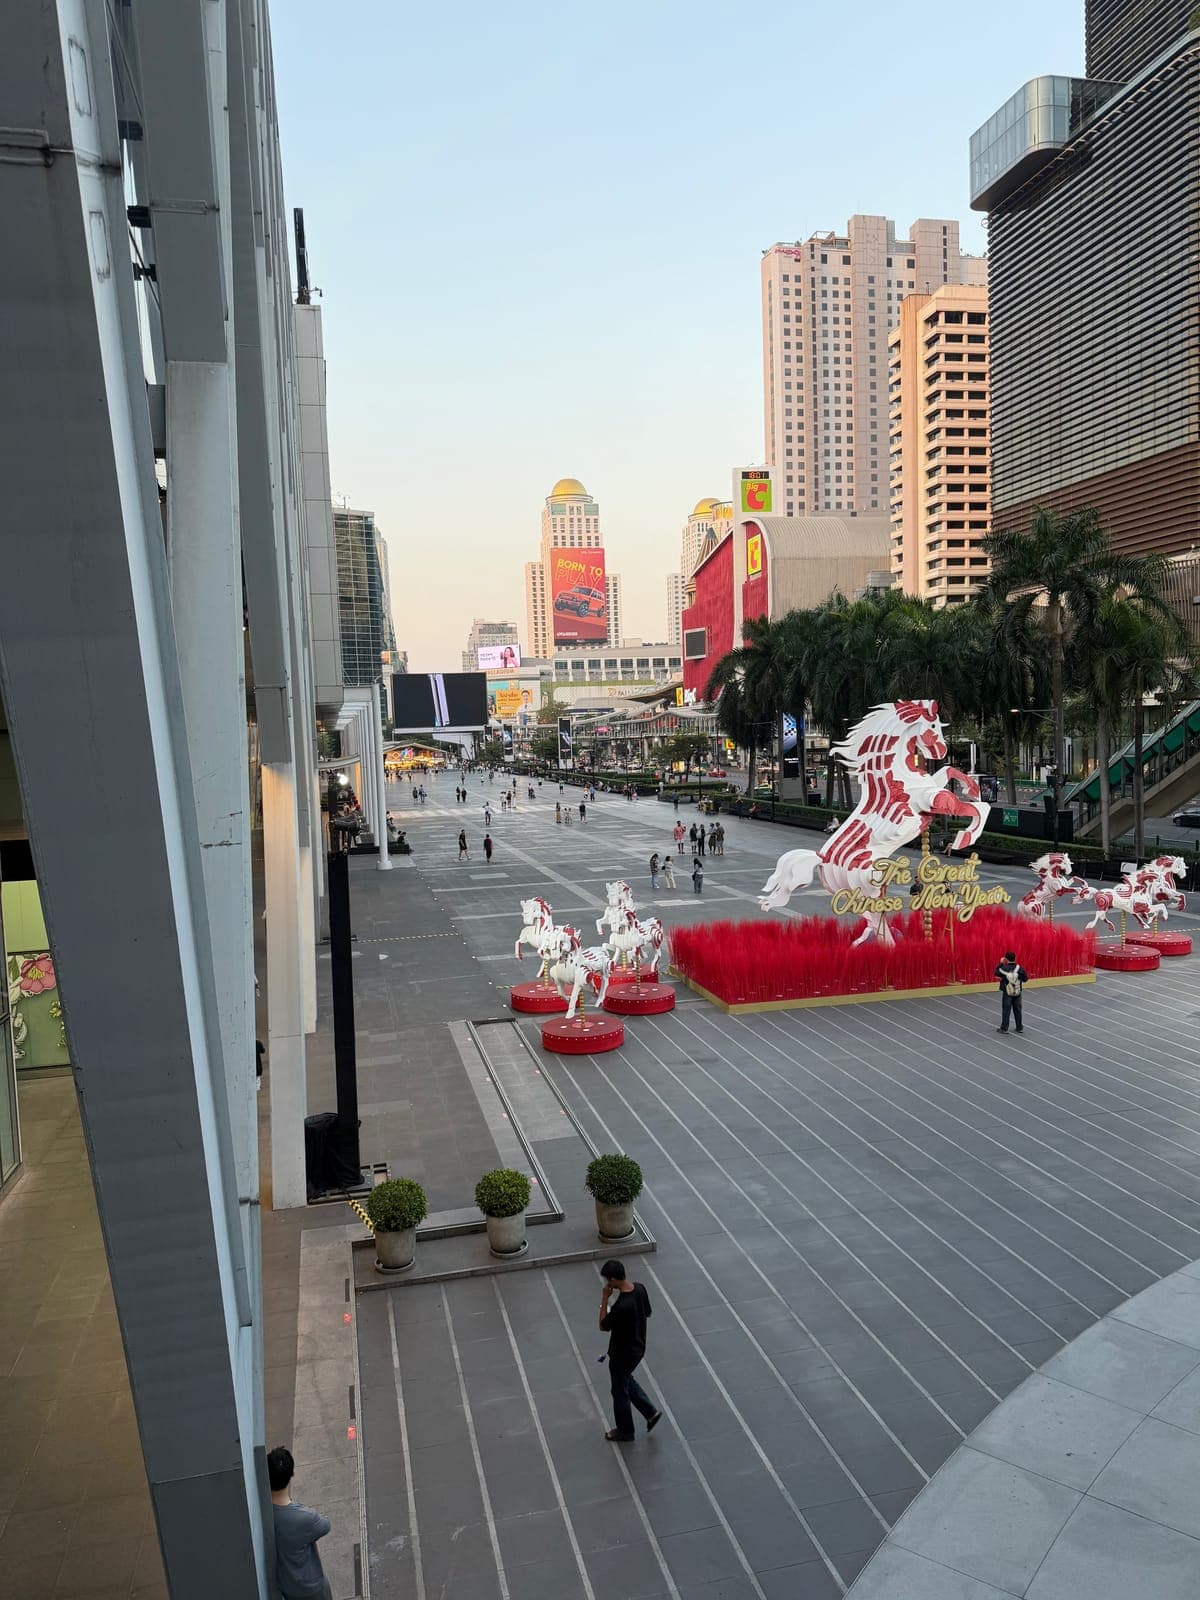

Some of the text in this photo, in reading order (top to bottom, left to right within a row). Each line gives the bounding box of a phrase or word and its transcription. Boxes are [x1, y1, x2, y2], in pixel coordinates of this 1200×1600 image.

[746, 482, 759, 492] Big
[747, 483, 768, 510] C
[555, 567, 601, 588] PLAY
[557, 558, 603, 576] BORN TO
[870, 852, 982, 888] The Great
[831, 883, 1012, 923] Chinese New Year
